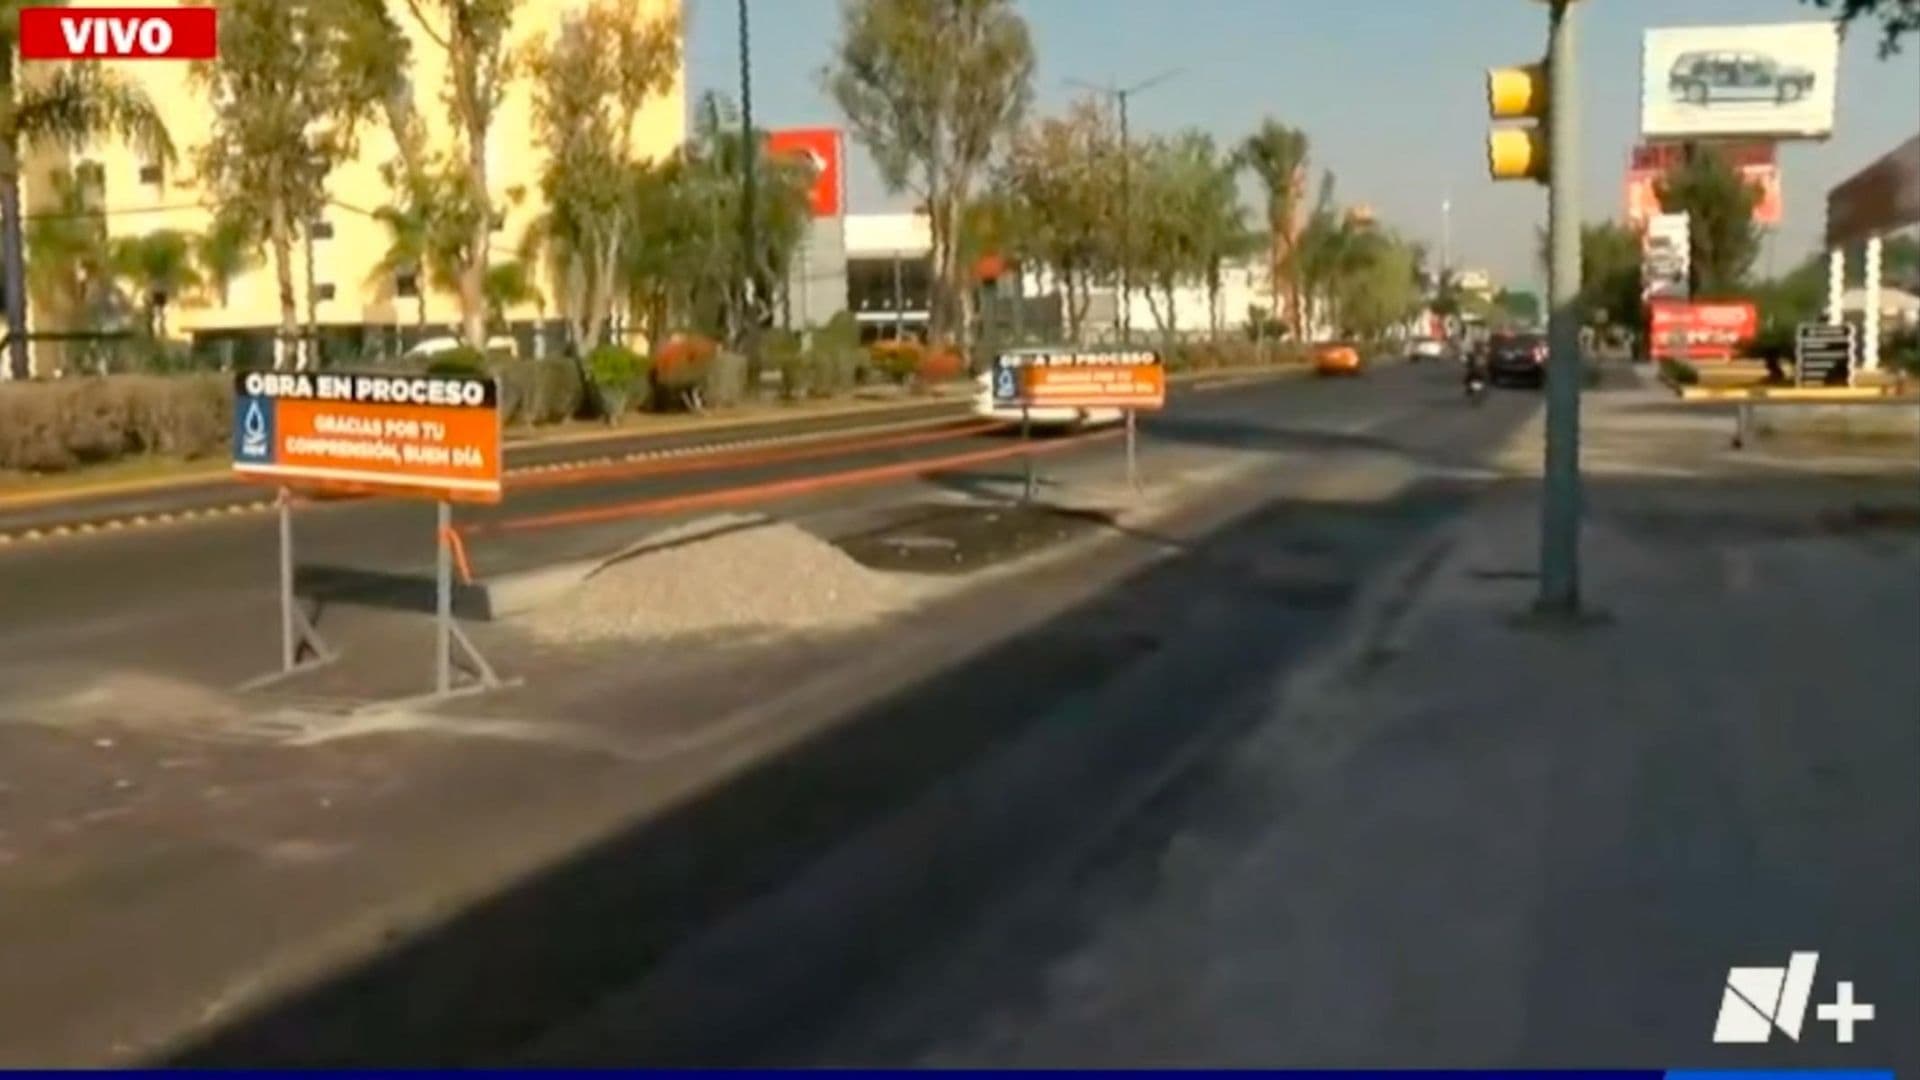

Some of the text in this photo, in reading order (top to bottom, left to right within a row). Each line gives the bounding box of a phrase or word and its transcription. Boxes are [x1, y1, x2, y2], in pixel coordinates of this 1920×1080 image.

[246, 372, 484, 405] OBRA EN PROCESO
[314, 414, 445, 441] GRACIAS POR TU
[402, 444, 449, 465] BUEN
[451, 446, 484, 469] DÍA
